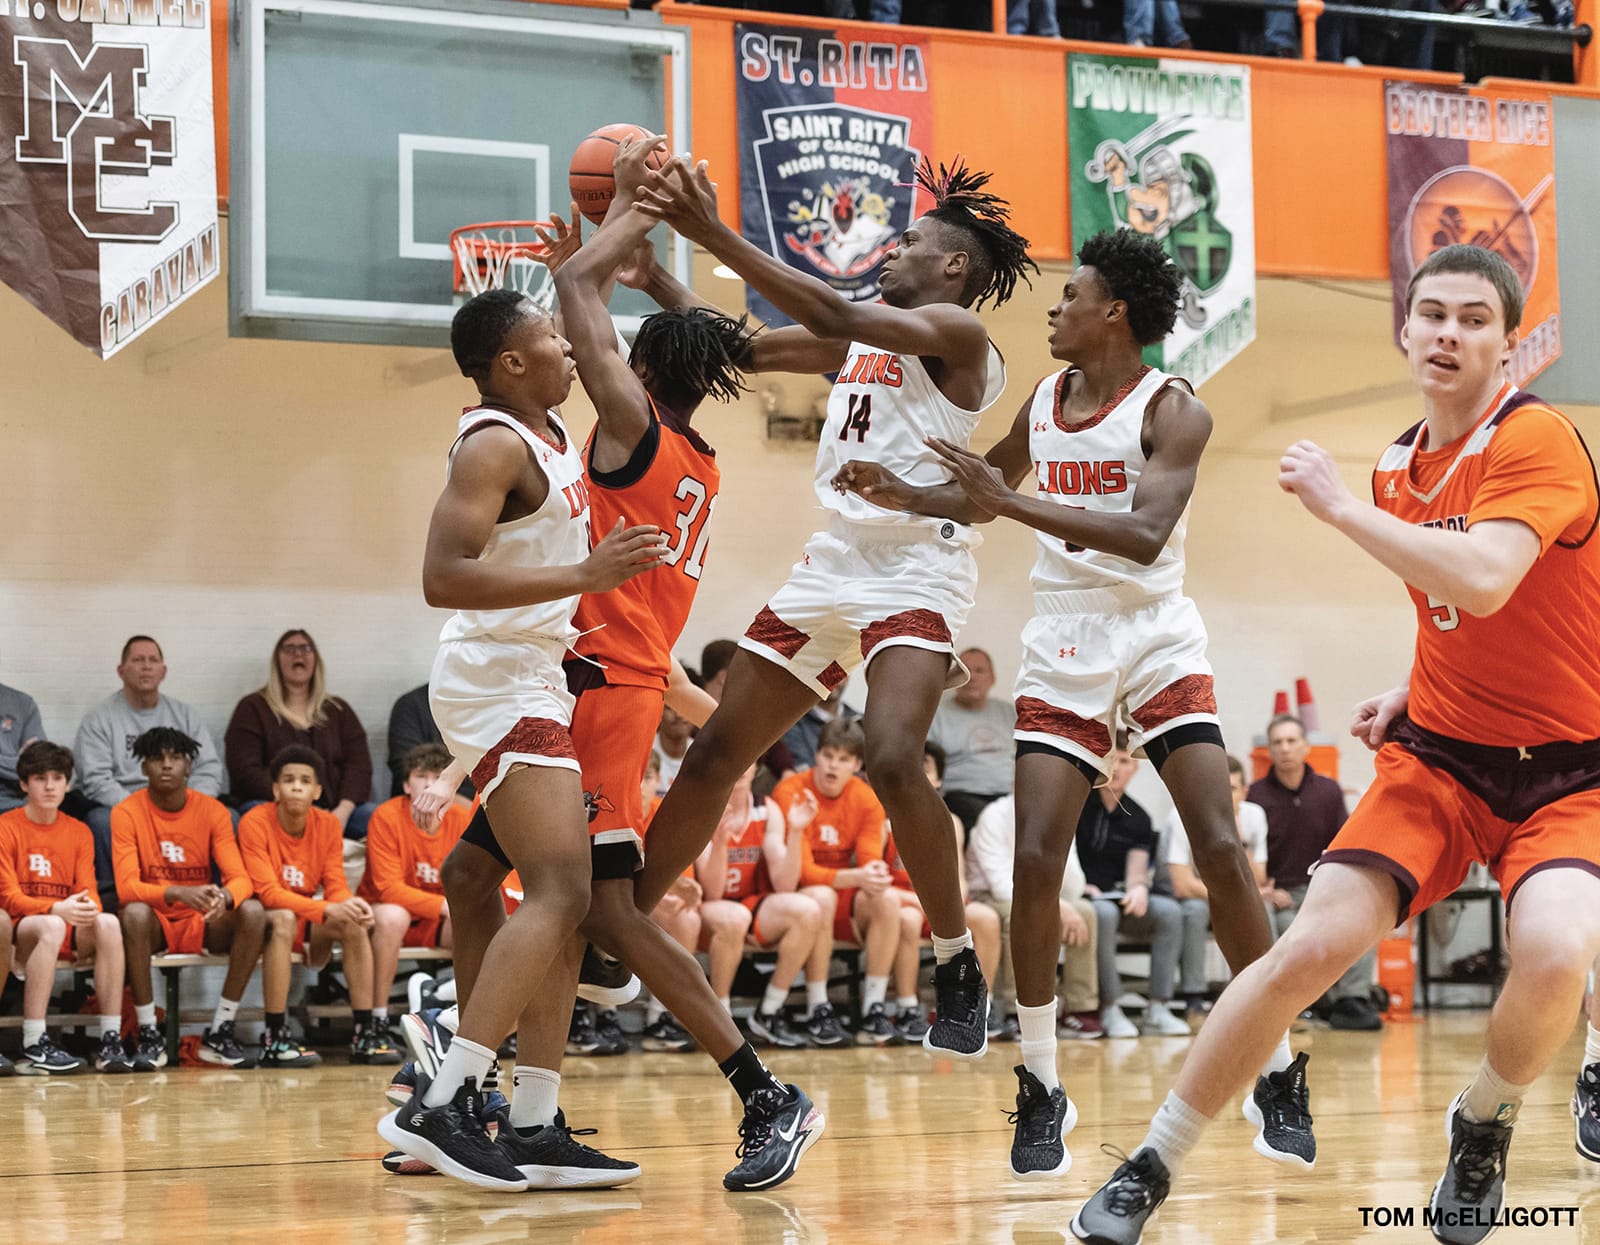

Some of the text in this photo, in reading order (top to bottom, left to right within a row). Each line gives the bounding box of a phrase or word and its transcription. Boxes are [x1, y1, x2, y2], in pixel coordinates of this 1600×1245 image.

[741, 32, 928, 92] ST. RITA
[1072, 61, 1246, 121] PROVIDENCE
[1386, 88, 1550, 146] BROTHER RICE
[773, 115, 905, 148] SAINT RITA
[798, 140, 821, 154] OF
[777, 153, 901, 187] HIGH SCHOOL
[101, 222, 217, 352] CARAVAN
[838, 393, 873, 443] 14
